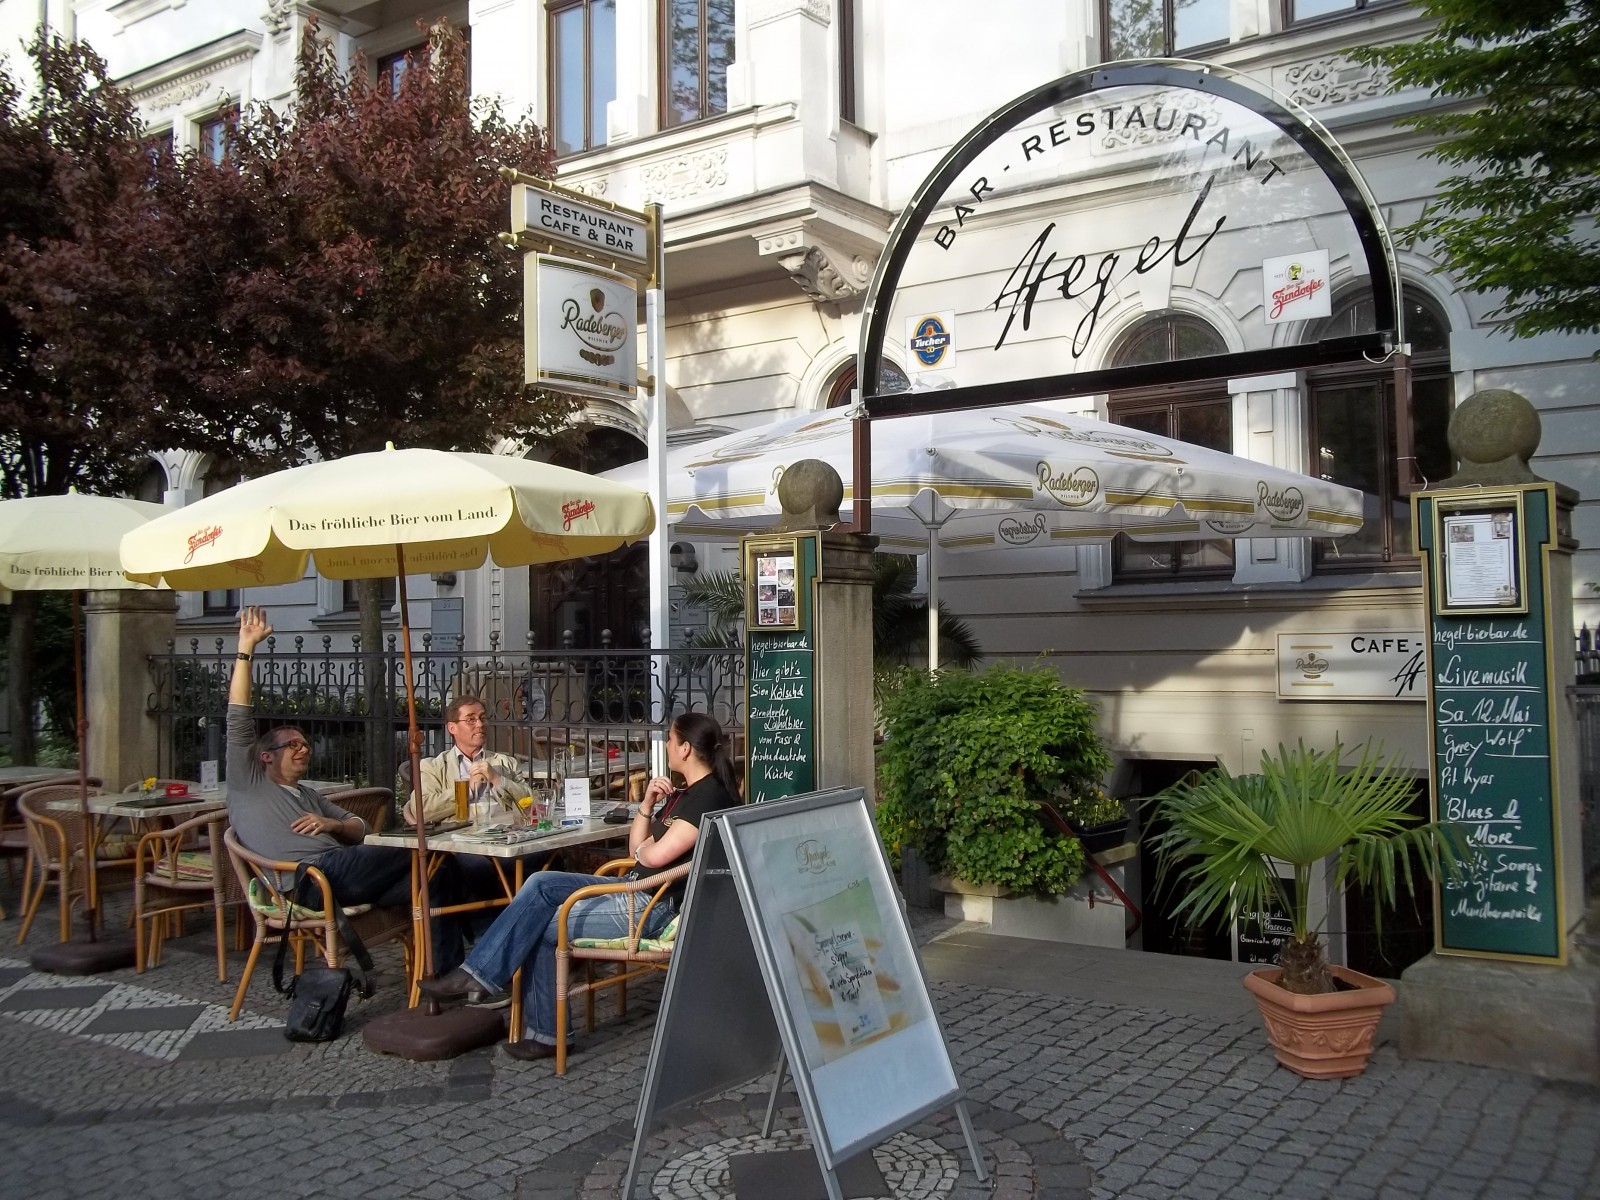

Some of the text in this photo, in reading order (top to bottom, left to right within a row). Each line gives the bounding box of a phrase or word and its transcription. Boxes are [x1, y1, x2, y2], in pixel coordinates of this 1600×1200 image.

[934, 175, 995, 251] BAR
[1020, 104, 1287, 187] RESTAURANT
[541, 199, 634, 237] RESTAURANT
[541, 215, 634, 252] CAFE & BAR
[983, 175, 1228, 359] Hegel
[1270, 279, 1325, 319] Zirndorfer
[560, 298, 628, 352] Radeberger
[915, 337, 947, 348] Tucher
[1036, 460, 1100, 507] Radeberger
[1256, 480, 1305, 521] Radeberger
[289, 507, 498, 531] Das fröhliche Bier vom Land.
[10, 564, 31, 576] Das
[34, 566, 86, 577] fröhliche
[89, 567, 113, 577] Bier
[1351, 637, 1409, 653] CAFE
[1433, 622, 1529, 651] hegel-bierbar.de
[752, 659, 801, 683] Hier gibt's
[1438, 654, 1528, 687] Livemusik
[1437, 698, 1468, 724] Sa.
[758, 736, 772, 744] vom
[764, 764, 794, 780] Küche
[1441, 766, 1457, 788] Pit
